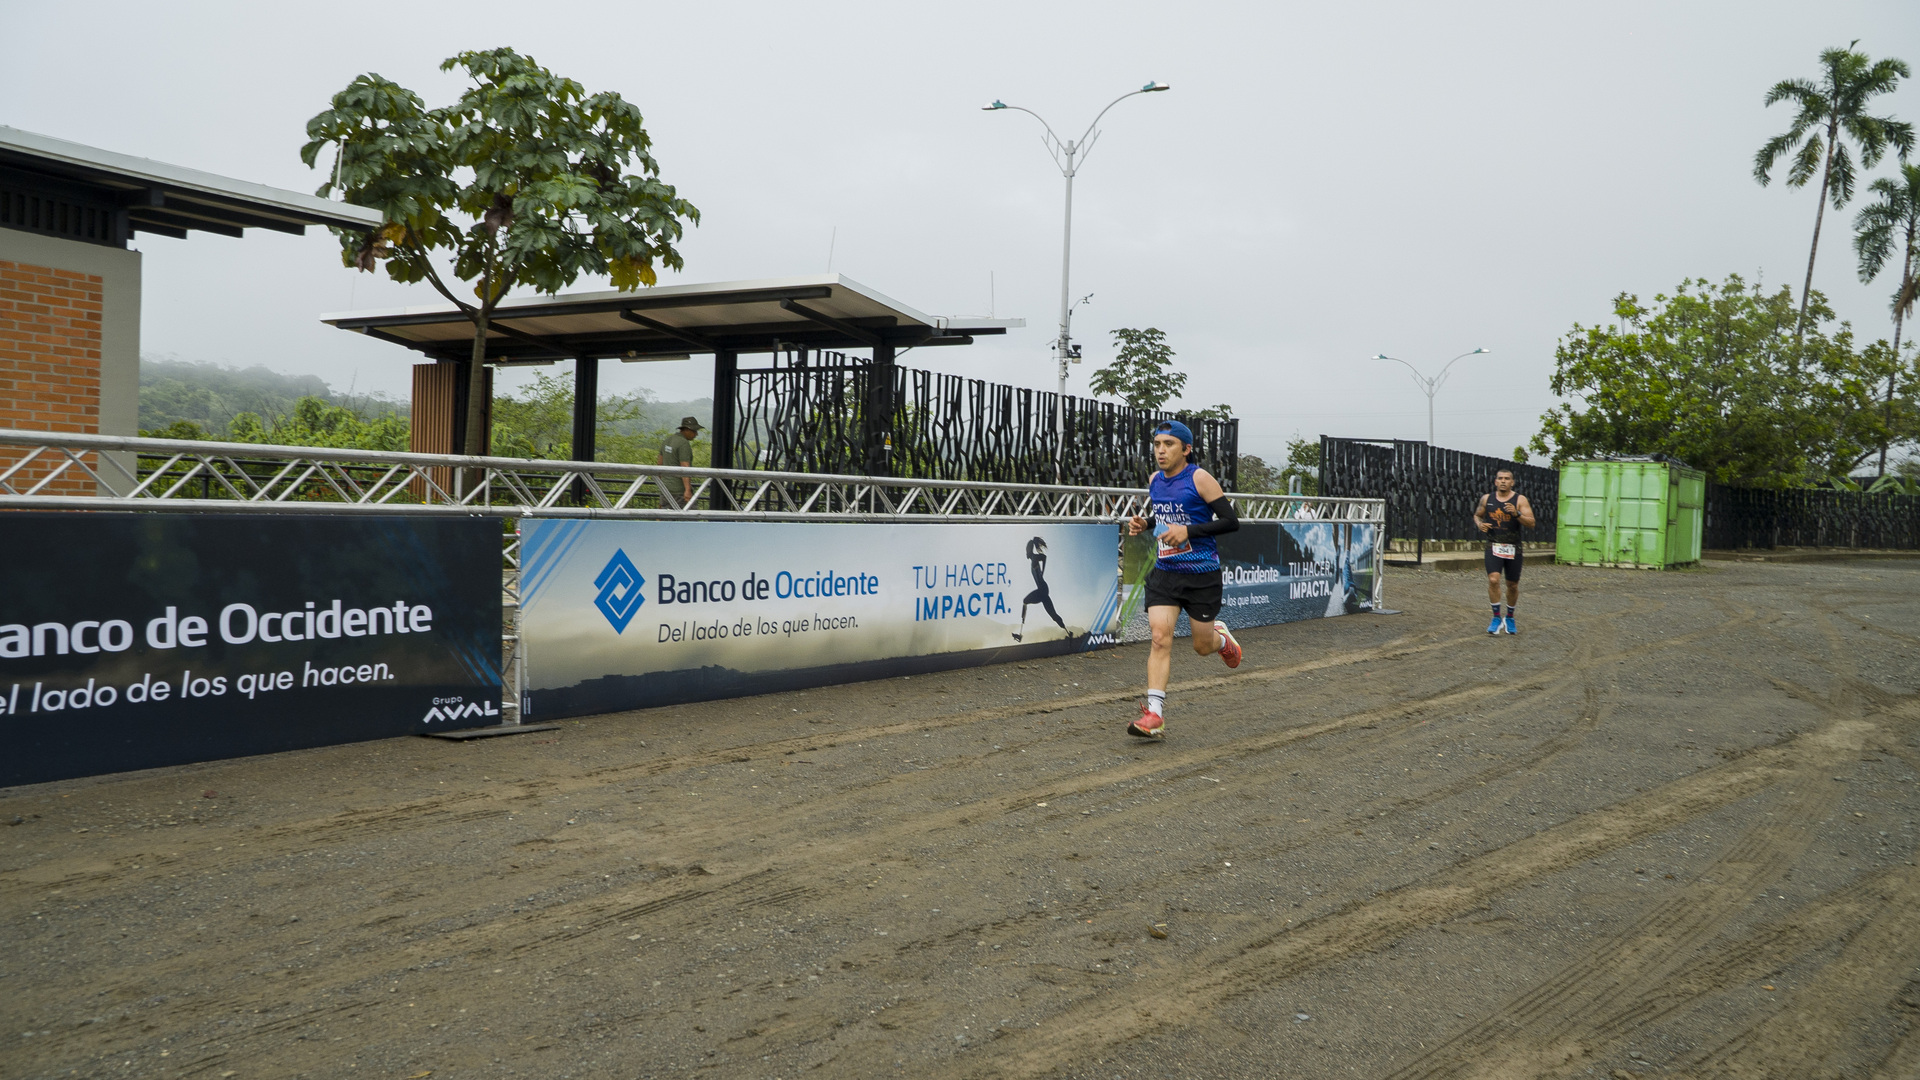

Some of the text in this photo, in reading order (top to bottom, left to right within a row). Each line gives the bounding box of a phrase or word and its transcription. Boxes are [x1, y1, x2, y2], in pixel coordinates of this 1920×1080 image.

[1153, 502, 1173, 513] enel
[912, 562, 1012, 590] TU HACER,
[1222, 565, 1279, 585] de Occidente
[1289, 562, 1300, 579] TU
[657, 569, 879, 606] Banco de Occidente
[1289, 580, 1332, 600] IMPACTA.
[915, 591, 1012, 622] IMPACTA.
[1227, 594, 1236, 607] los
[1237, 596, 1249, 609] que
[1250, 592, 1270, 605] hacen.
[146, 606, 208, 650] de
[220, 598, 432, 645] Occidente
[657, 610, 859, 644] Del lado de los que hacen.
[1087, 633, 1115, 646] AVAL
[31, 678, 117, 713] lado
[127, 674, 171, 703] de
[180, 670, 228, 699] los
[237, 672, 294, 700] que
[303, 661, 395, 688] hacen.
[423, 700, 499, 724] AVAL
[432, 696, 464, 706] Grupo
